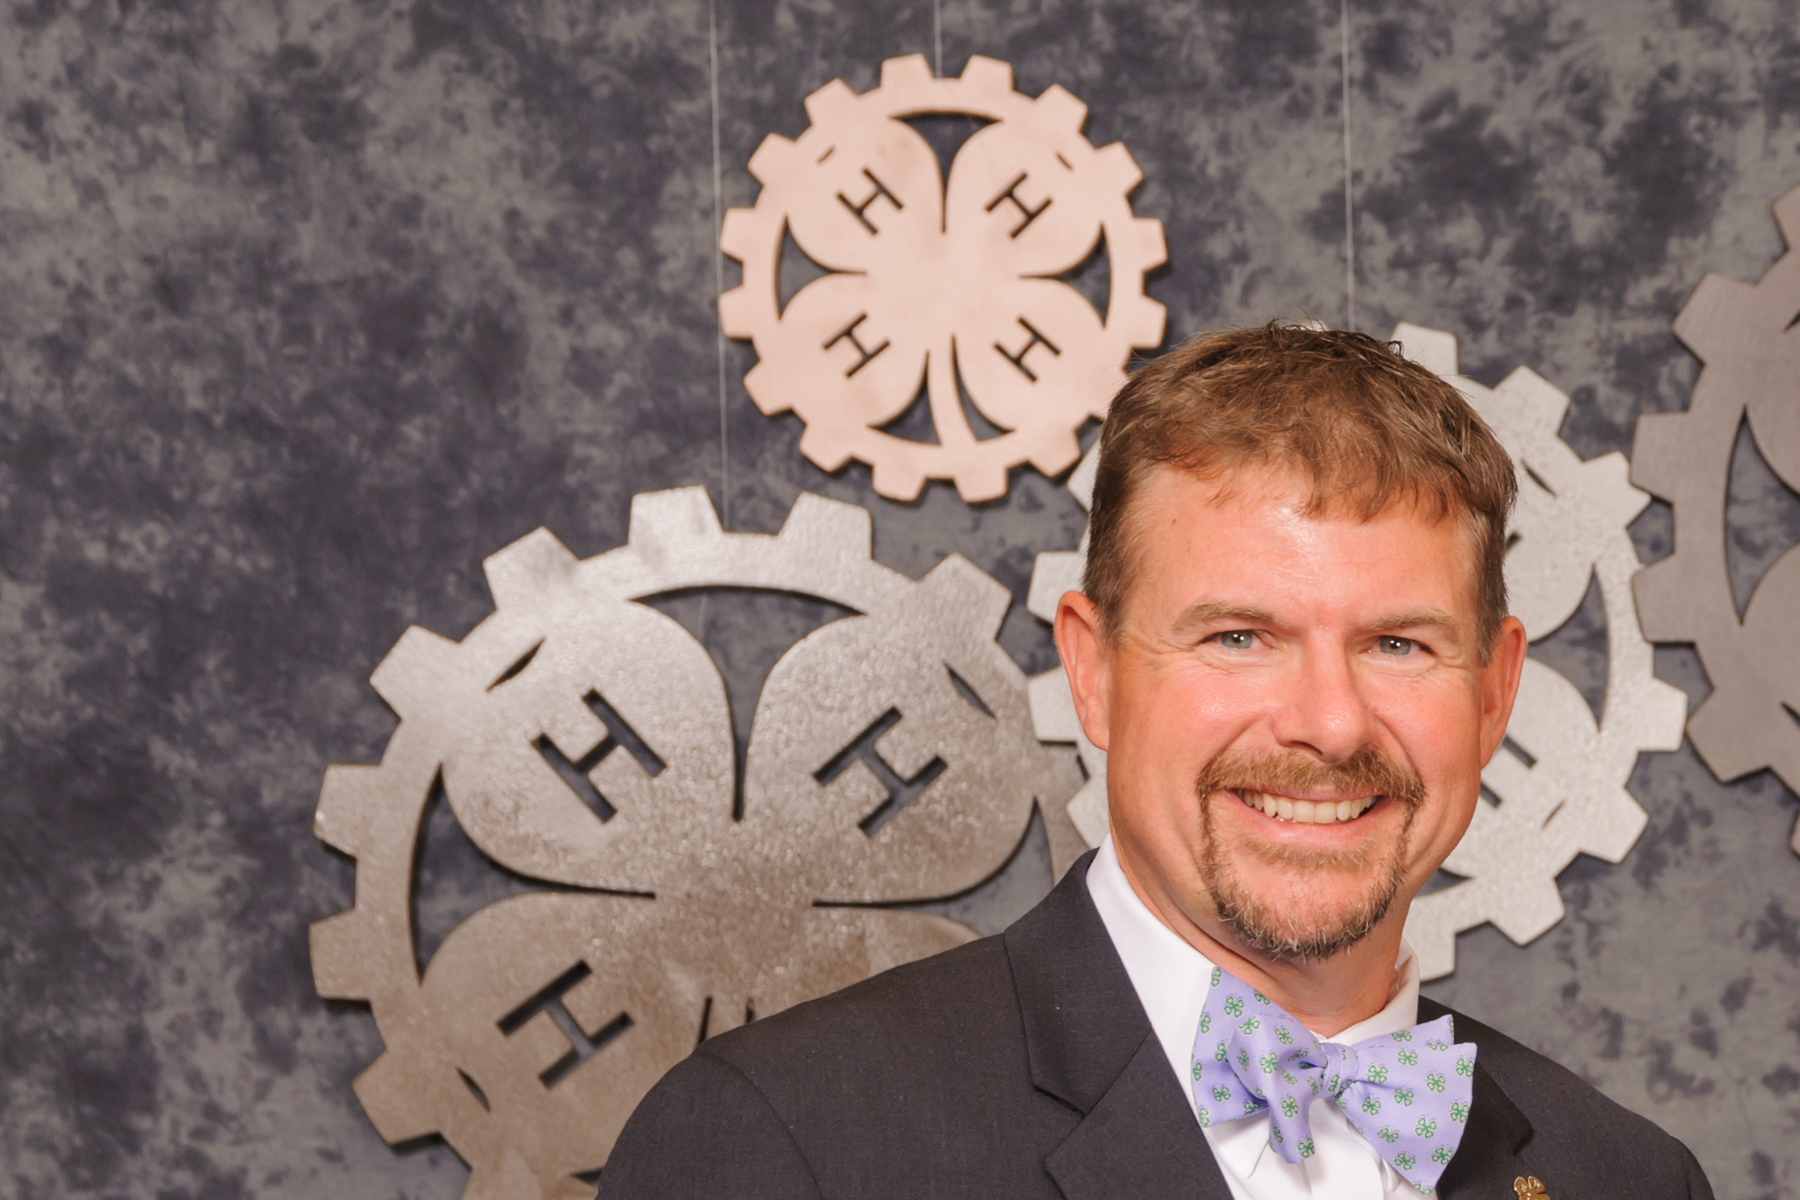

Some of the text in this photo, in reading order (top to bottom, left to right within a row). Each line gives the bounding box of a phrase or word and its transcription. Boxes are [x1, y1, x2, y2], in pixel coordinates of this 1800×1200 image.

[838, 168, 904, 234] H
[986, 173, 1052, 239] H
[824, 313, 890, 377] H
[994, 317, 1060, 381] H
[531, 690, 666, 821] H
[814, 707, 947, 837] H
[498, 960, 633, 1088] H
